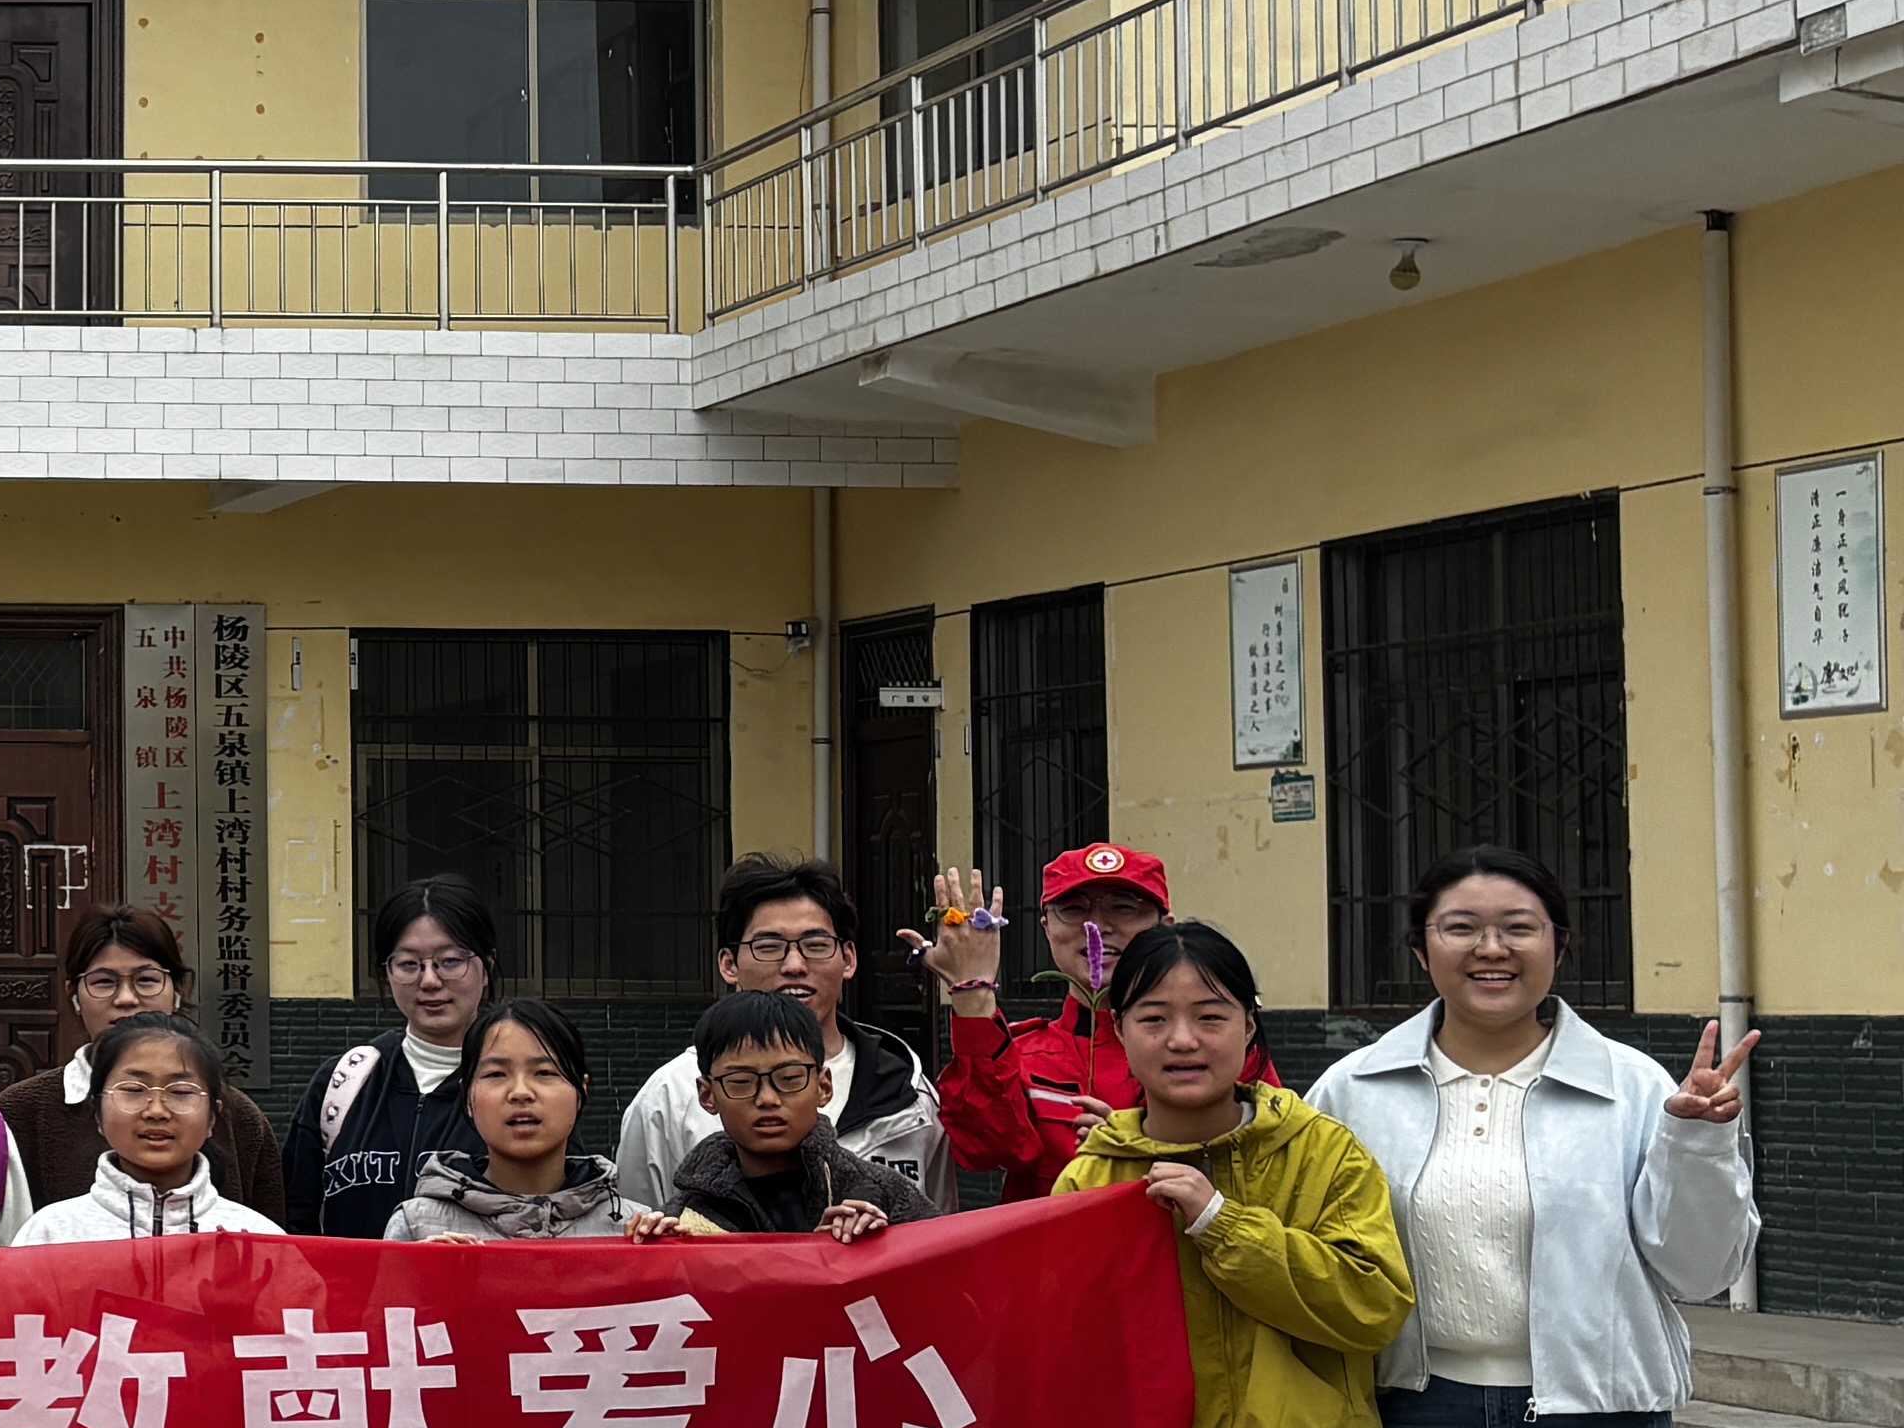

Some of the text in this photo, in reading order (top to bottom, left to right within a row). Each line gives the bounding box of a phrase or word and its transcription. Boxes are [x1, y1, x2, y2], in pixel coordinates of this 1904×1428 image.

[133, 627, 158, 768] 五泉镇
[163, 625, 188, 768] 中共杨陵区
[141, 781, 185, 953] 上湾村支
[212, 614, 254, 1078] 杨陵区五泉镇上湾村村务监督委员会
